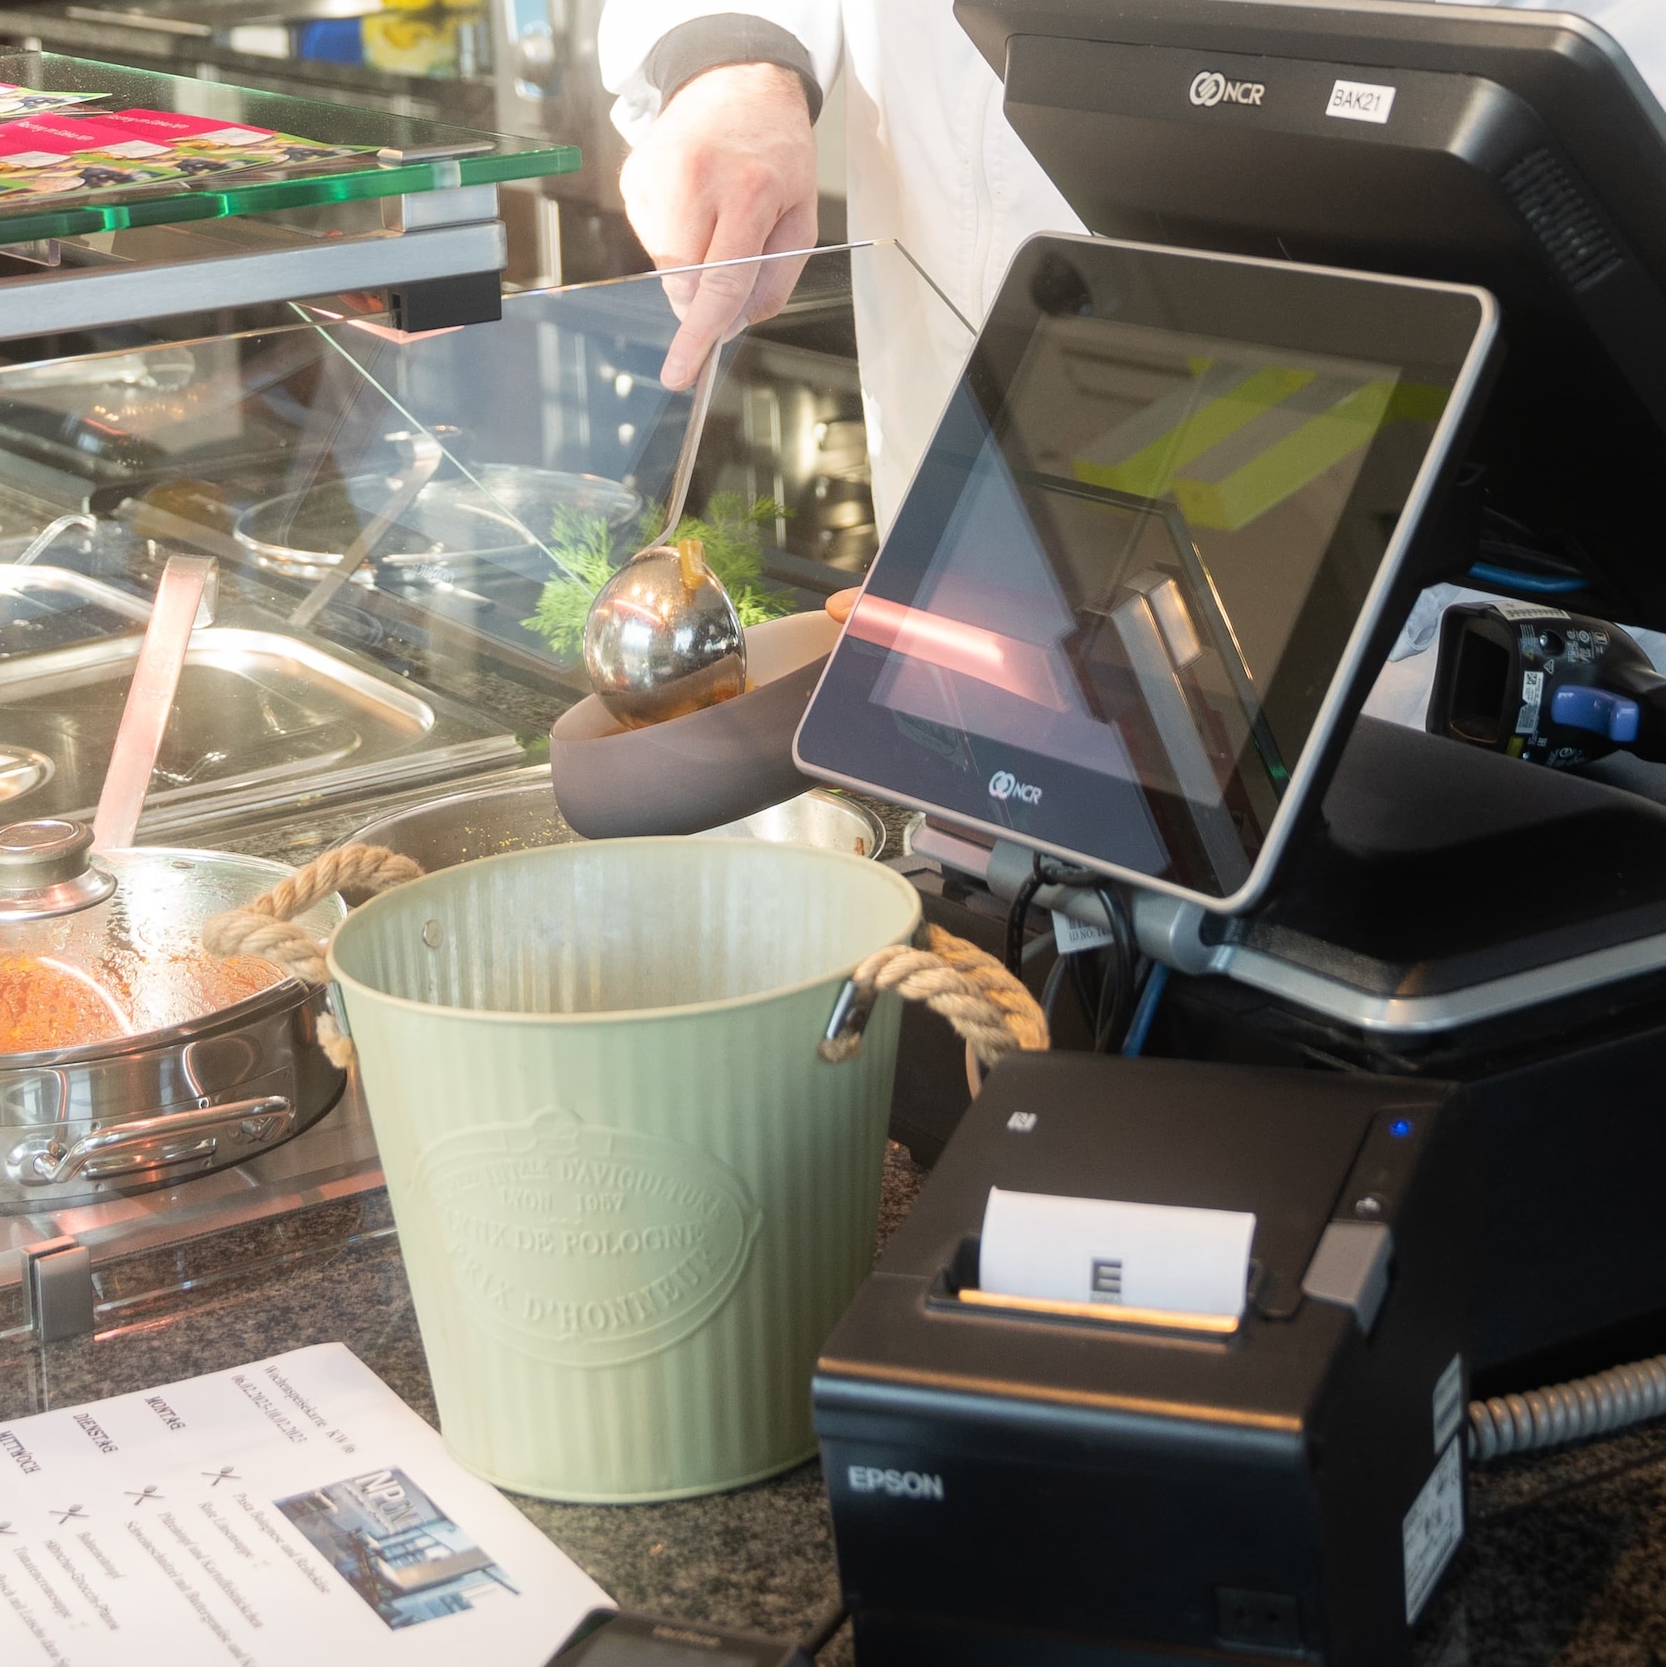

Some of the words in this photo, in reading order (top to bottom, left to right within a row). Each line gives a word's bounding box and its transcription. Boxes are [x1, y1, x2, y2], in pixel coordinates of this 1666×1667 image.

[1223, 81, 1266, 106] NCR
[1332, 89, 1381, 111] BAK21
[1012, 781, 1042, 805] NCR
[514, 1229, 554, 1255] DE
[561, 1219, 706, 1256] POLOGNE
[146, 1395, 185, 1430] MONTAG
[265, 1364, 327, 1427] Wochenspeisekarte
[326, 1428, 350, 1444] KW
[72, 1412, 118, 1453] DIENSTAG
[847, 1464, 945, 1501] EPSON
